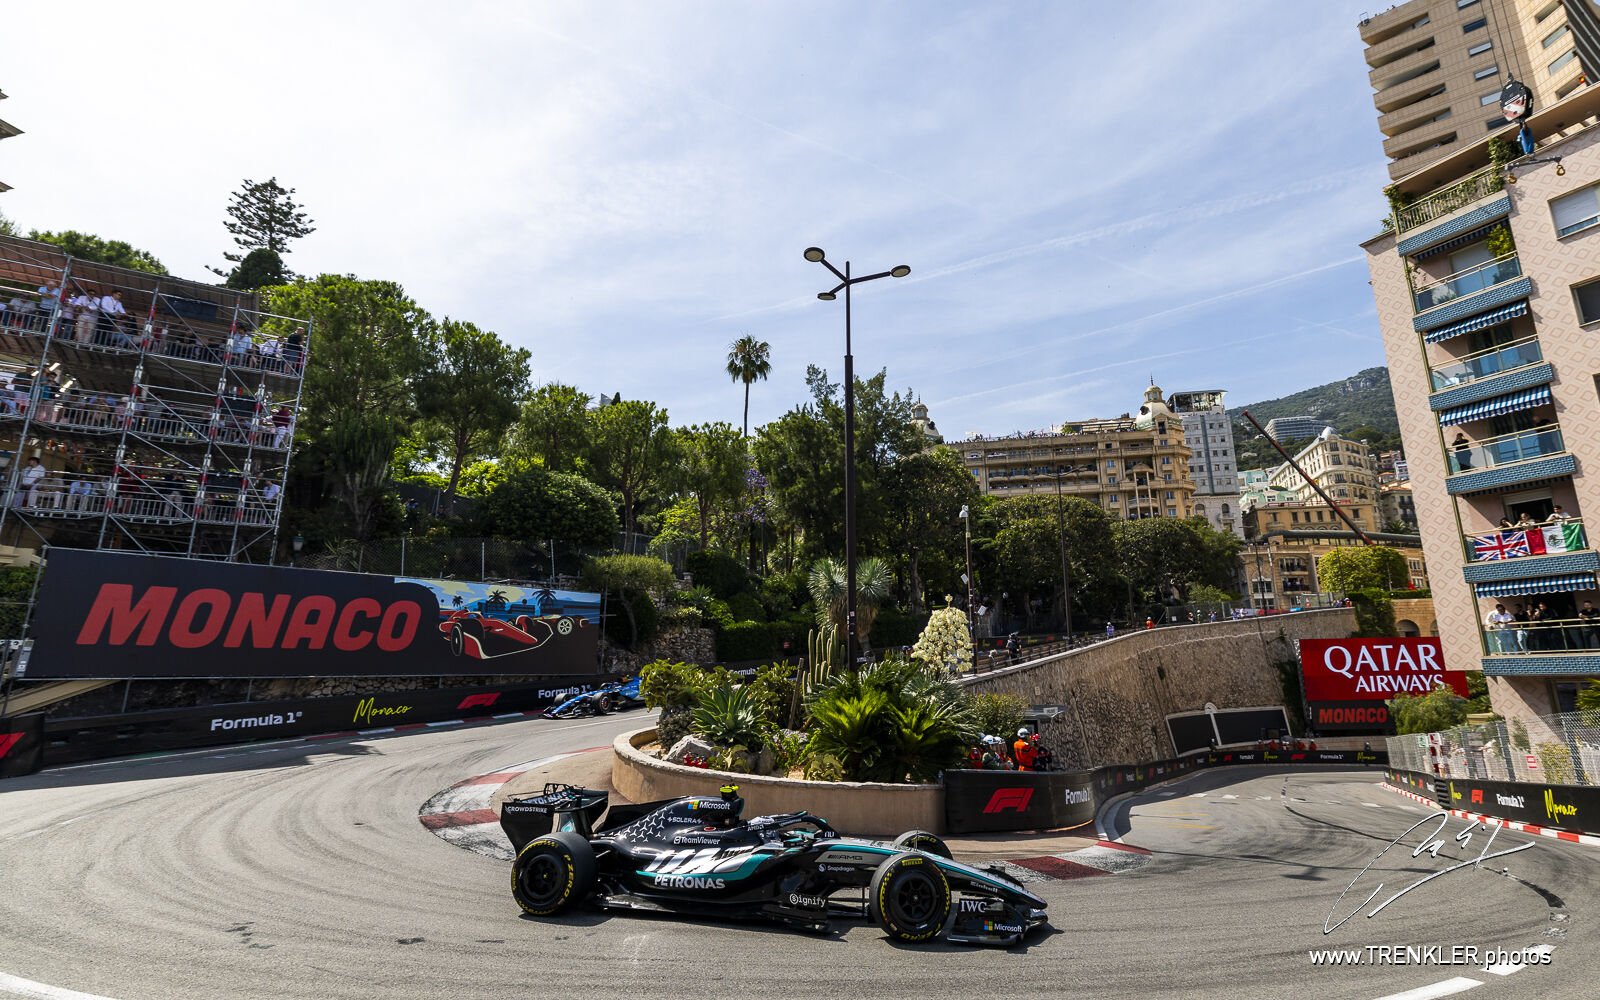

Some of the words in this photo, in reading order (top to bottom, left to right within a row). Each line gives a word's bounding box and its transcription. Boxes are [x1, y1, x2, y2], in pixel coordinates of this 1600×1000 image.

[76, 583, 422, 652] MONACO
[1323, 644, 1442, 679] QATAR
[1355, 674, 1446, 693] AIRWAYS
[538, 686, 580, 699] Formula
[353, 697, 413, 724] Monaco
[1319, 707, 1388, 723] MONACO
[211, 714, 283, 731] Formula
[1065, 789, 1086, 805] Formula
[1496, 793, 1518, 807] Formula
[507, 806, 548, 814] CROWDSTRIKE
[699, 801, 731, 810] Microsoft
[1544, 788, 1578, 824] Monaco
[681, 836, 721, 845] TeamViewer
[654, 874, 726, 889] PETRONAS
[960, 900, 987, 913] IWC
[994, 923, 1023, 933] Microsoft
